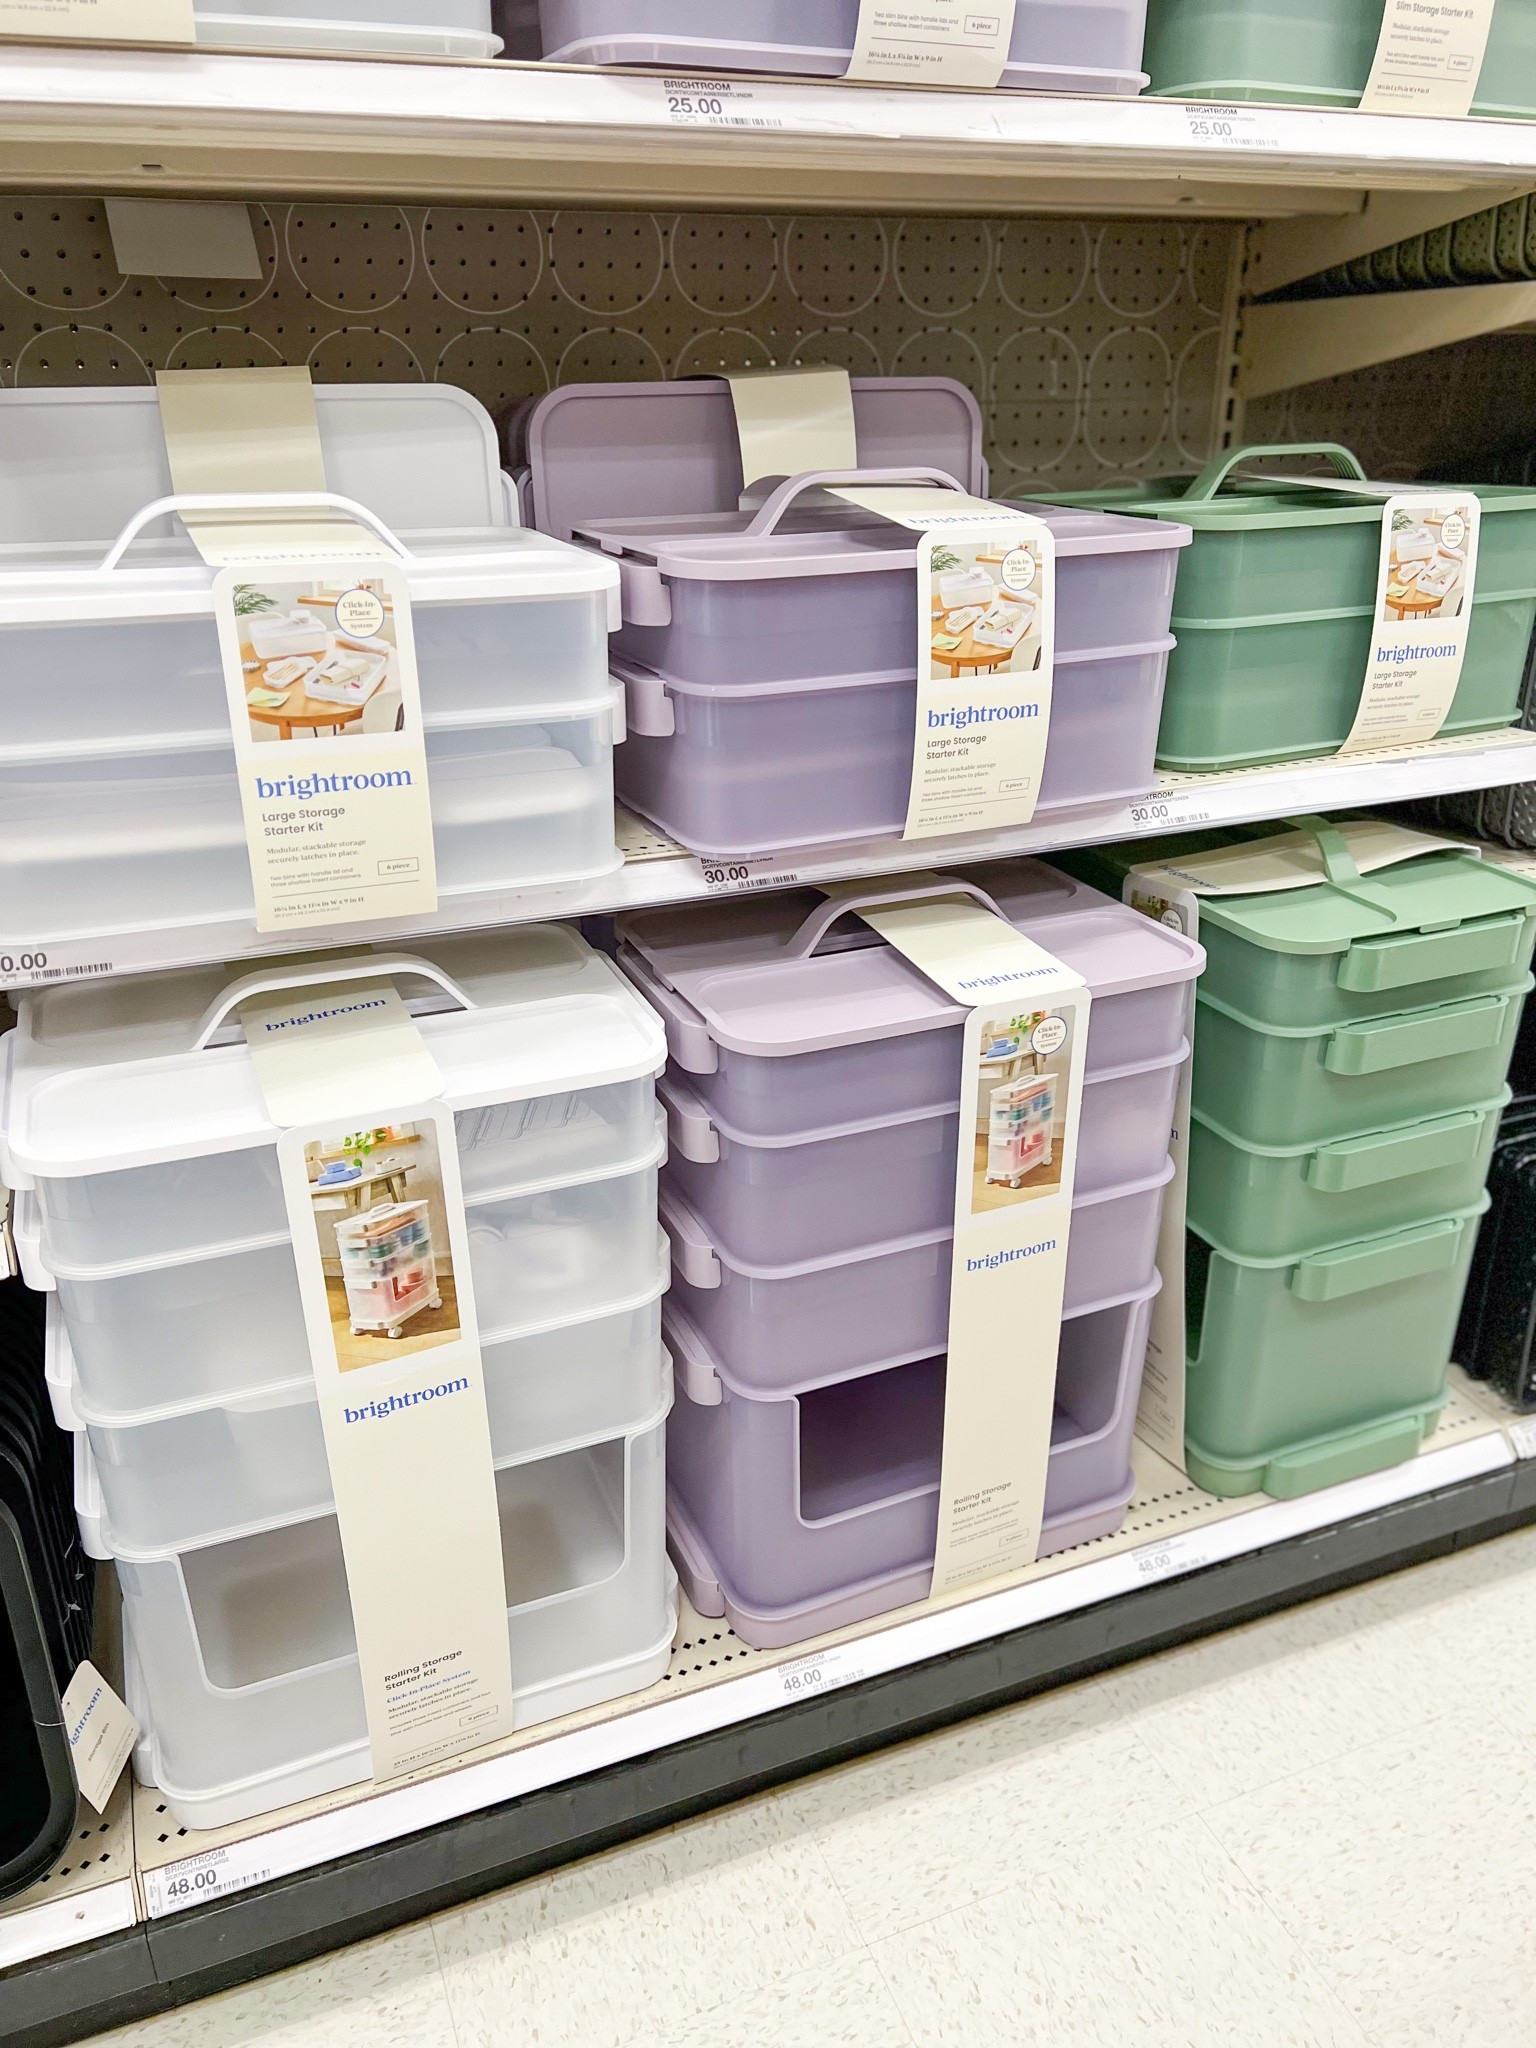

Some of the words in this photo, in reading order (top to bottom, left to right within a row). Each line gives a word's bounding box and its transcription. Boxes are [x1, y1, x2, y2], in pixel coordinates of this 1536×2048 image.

[1413, 3, 1439, 16] Storage
[1441, 7, 1463, 17] Starter
[1464, 9, 1474, 18] Kit
[664, 80, 731, 90] BRIGHTROOM
[668, 97, 722, 115] 25.00
[1186, 107, 1237, 115] BRIGHTROOM
[1190, 121, 1232, 136] 25.00
[1377, 644, 1457, 664] brightroom
[1374, 672, 1391, 680] Large
[1393, 670, 1417, 678] Storage
[928, 703, 1038, 729] brightroom
[928, 739, 951, 748] Large
[954, 735, 986, 745] Storage
[927, 750, 956, 759] Starter
[958, 748, 968, 756] Kit
[950, 764, 975, 772] stackable
[977, 762, 996, 770] storage
[255, 769, 412, 800] brightroom
[262, 811, 296, 823] Large
[299, 806, 345, 819] Storage
[1132, 805, 1168, 821] 30.00
[264, 824, 305, 836] Starter
[308, 822, 323, 832] Kit
[266, 846, 301, 855] Modular,
[302, 842, 337, 851] stackable
[339, 839, 366, 848] storage
[268, 855, 299, 865] securely
[300, 852, 327, 861] latches
[338, 850, 359, 858] place.
[392, 862, 410, 871] piece
[288, 878, 311, 886] shallow
[330, 873, 361, 881] containers
[705, 866, 748, 884] 30.00
[0, 952, 47, 972] 0.00
[958, 967, 1058, 989] brightroom
[266, 999, 387, 1032] brightroom
[1042, 1031, 1057, 1039] Place
[967, 1239, 1056, 1271] brightroom
[343, 1377, 469, 1424] brightroom
[954, 1492, 979, 1505] Rolling
[982, 1482, 1012, 1496] Storage
[953, 1501, 979, 1514] Starter
[981, 1496, 991, 1504] Kit
[1139, 1554, 1170, 1572] 48.00
[384, 1665, 420, 1682] Rolling
[422, 1650, 462, 1668] Storage
[778, 1653, 825, 1674] BRIGHTROOM
[386, 1674, 421, 1690] Starter
[423, 1668, 437, 1677] Kit
[442, 1670, 471, 1683] System
[784, 1669, 821, 1691] 48.00
[421, 1687, 453, 1702] stackable
[454, 1678, 478, 1689] storage
[69, 1687, 102, 1745] ightroom
[88, 1734, 103, 1762] Storage
[164, 1849, 226, 1876] BRIGHTROOM
[168, 1870, 216, 1896] 48.00
